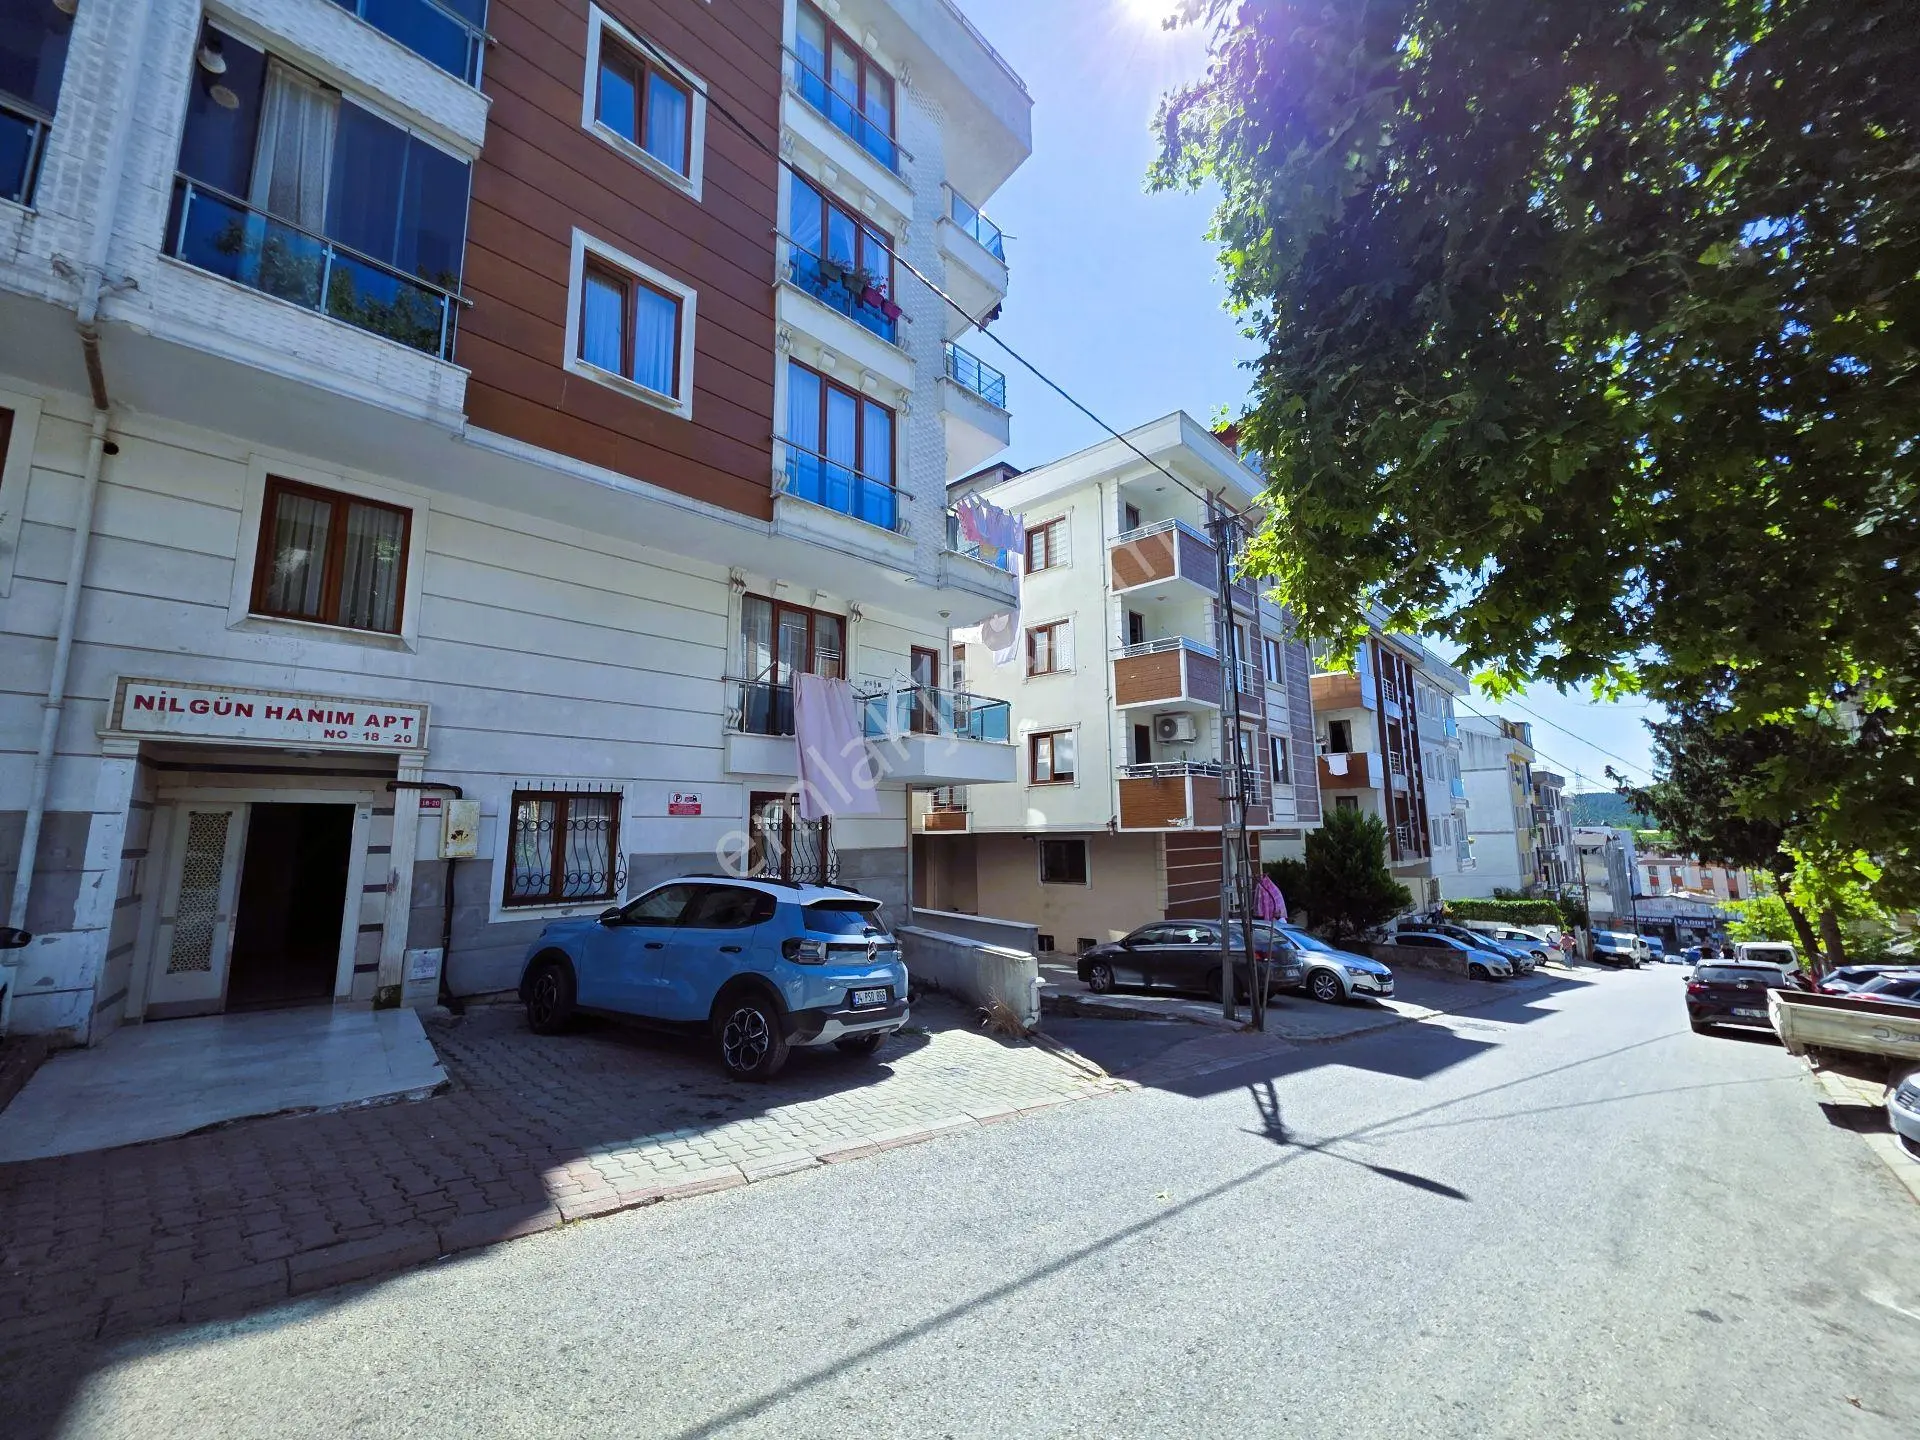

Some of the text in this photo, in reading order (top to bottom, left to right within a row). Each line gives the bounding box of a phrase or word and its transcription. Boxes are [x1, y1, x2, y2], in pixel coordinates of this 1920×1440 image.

[133, 691, 414, 731] NİLGÜN HANIM APT
[323, 729, 348, 739] NO
[363, 732, 380, 741] 18
[393, 734, 412, 743] 20
